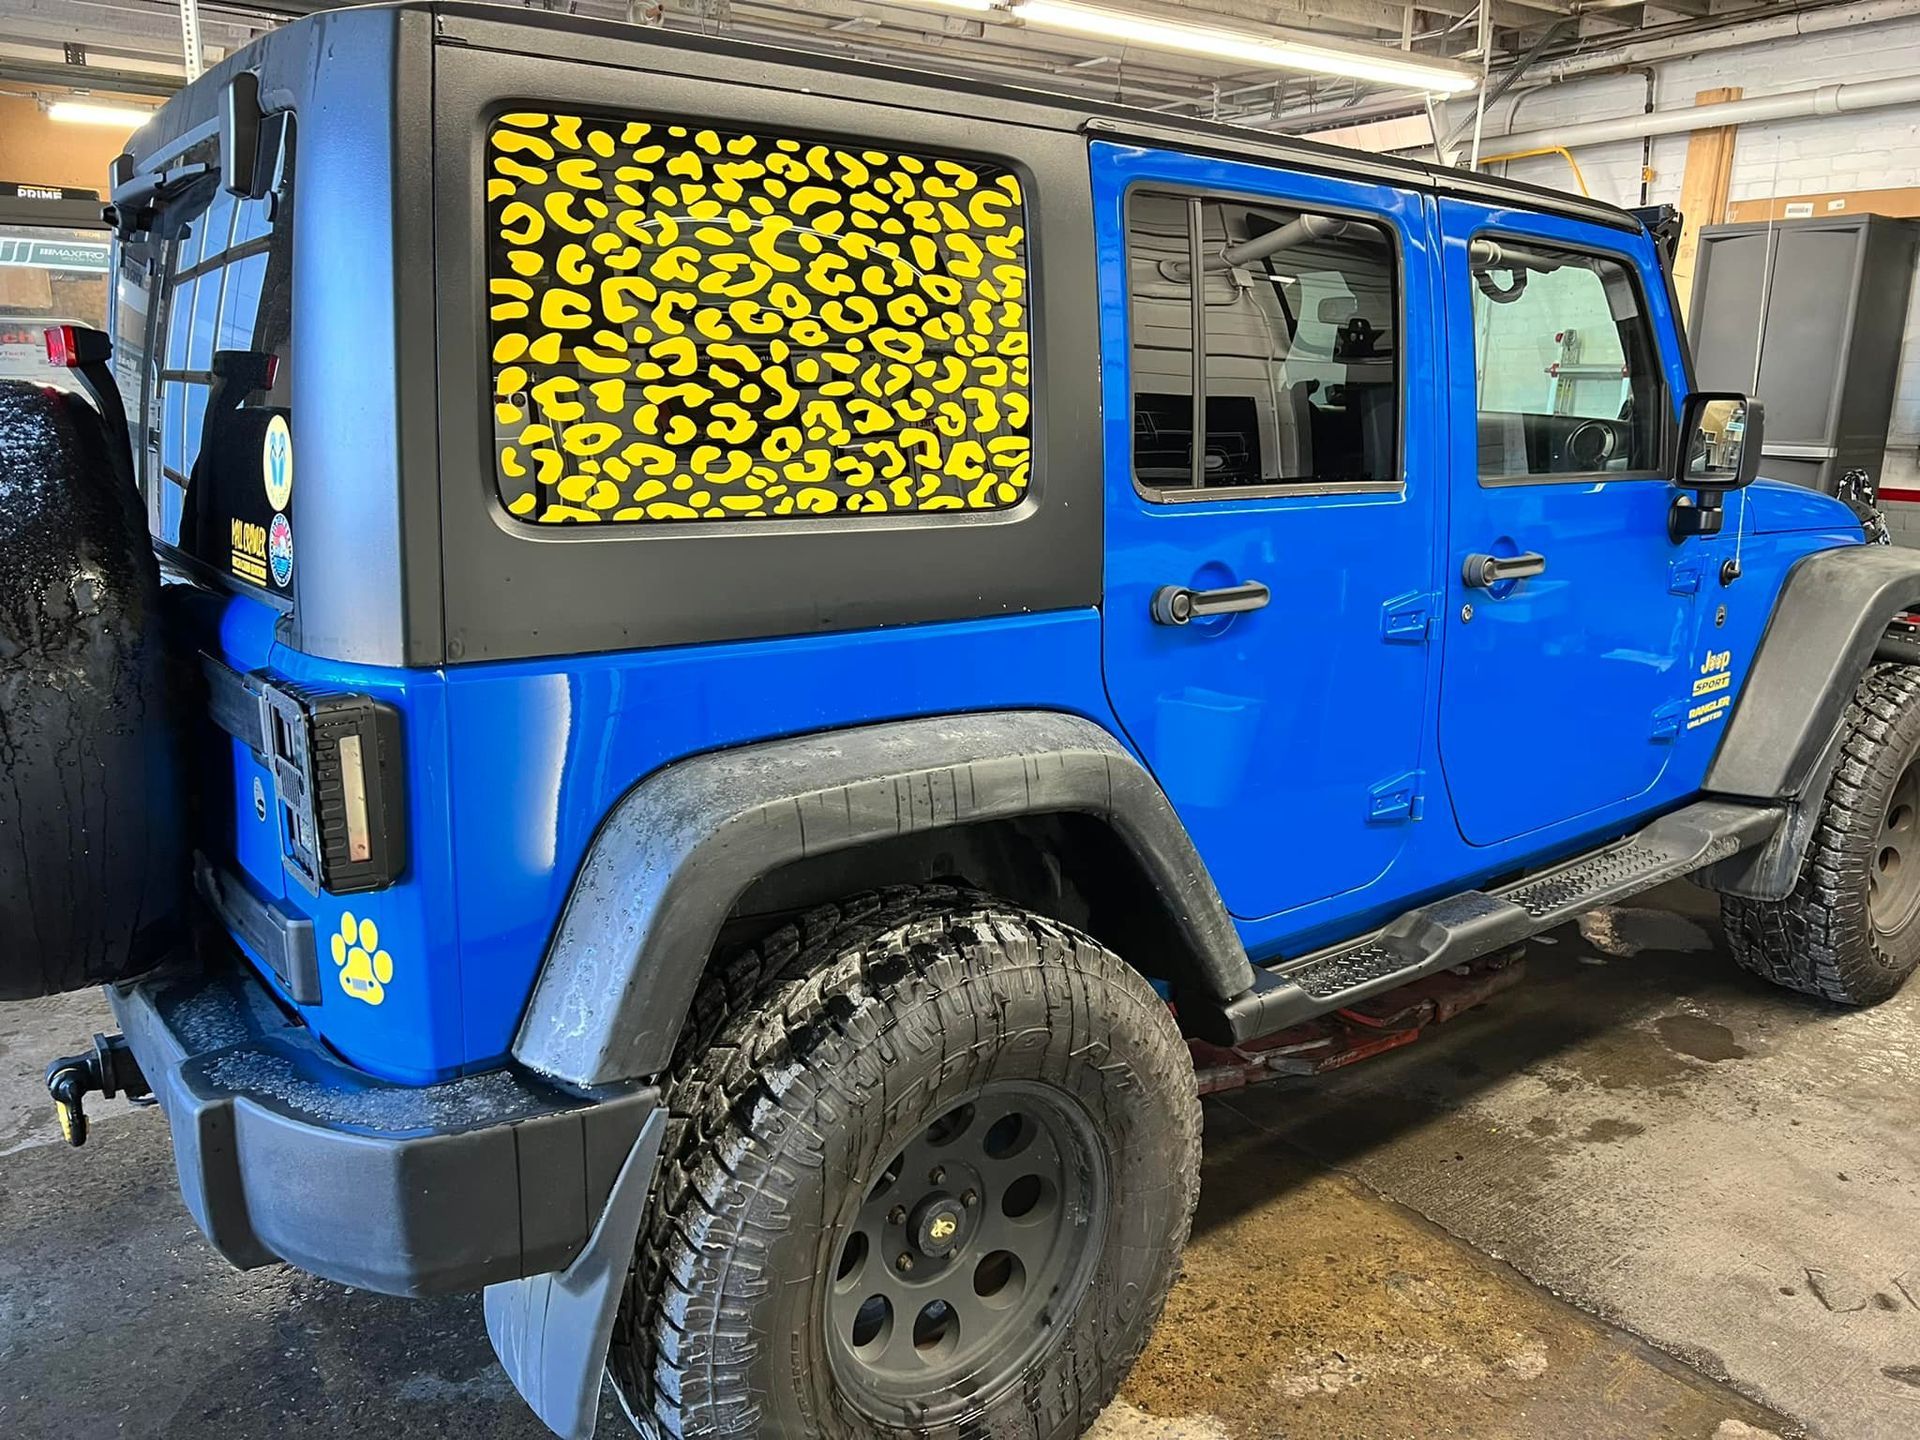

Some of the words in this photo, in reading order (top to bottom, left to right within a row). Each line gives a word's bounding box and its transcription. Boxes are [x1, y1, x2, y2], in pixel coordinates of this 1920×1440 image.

[1701, 650, 1731, 674] Jeep
[1696, 677, 1727, 692] SPORT
[1687, 710, 1723, 730] UNLIMITED
